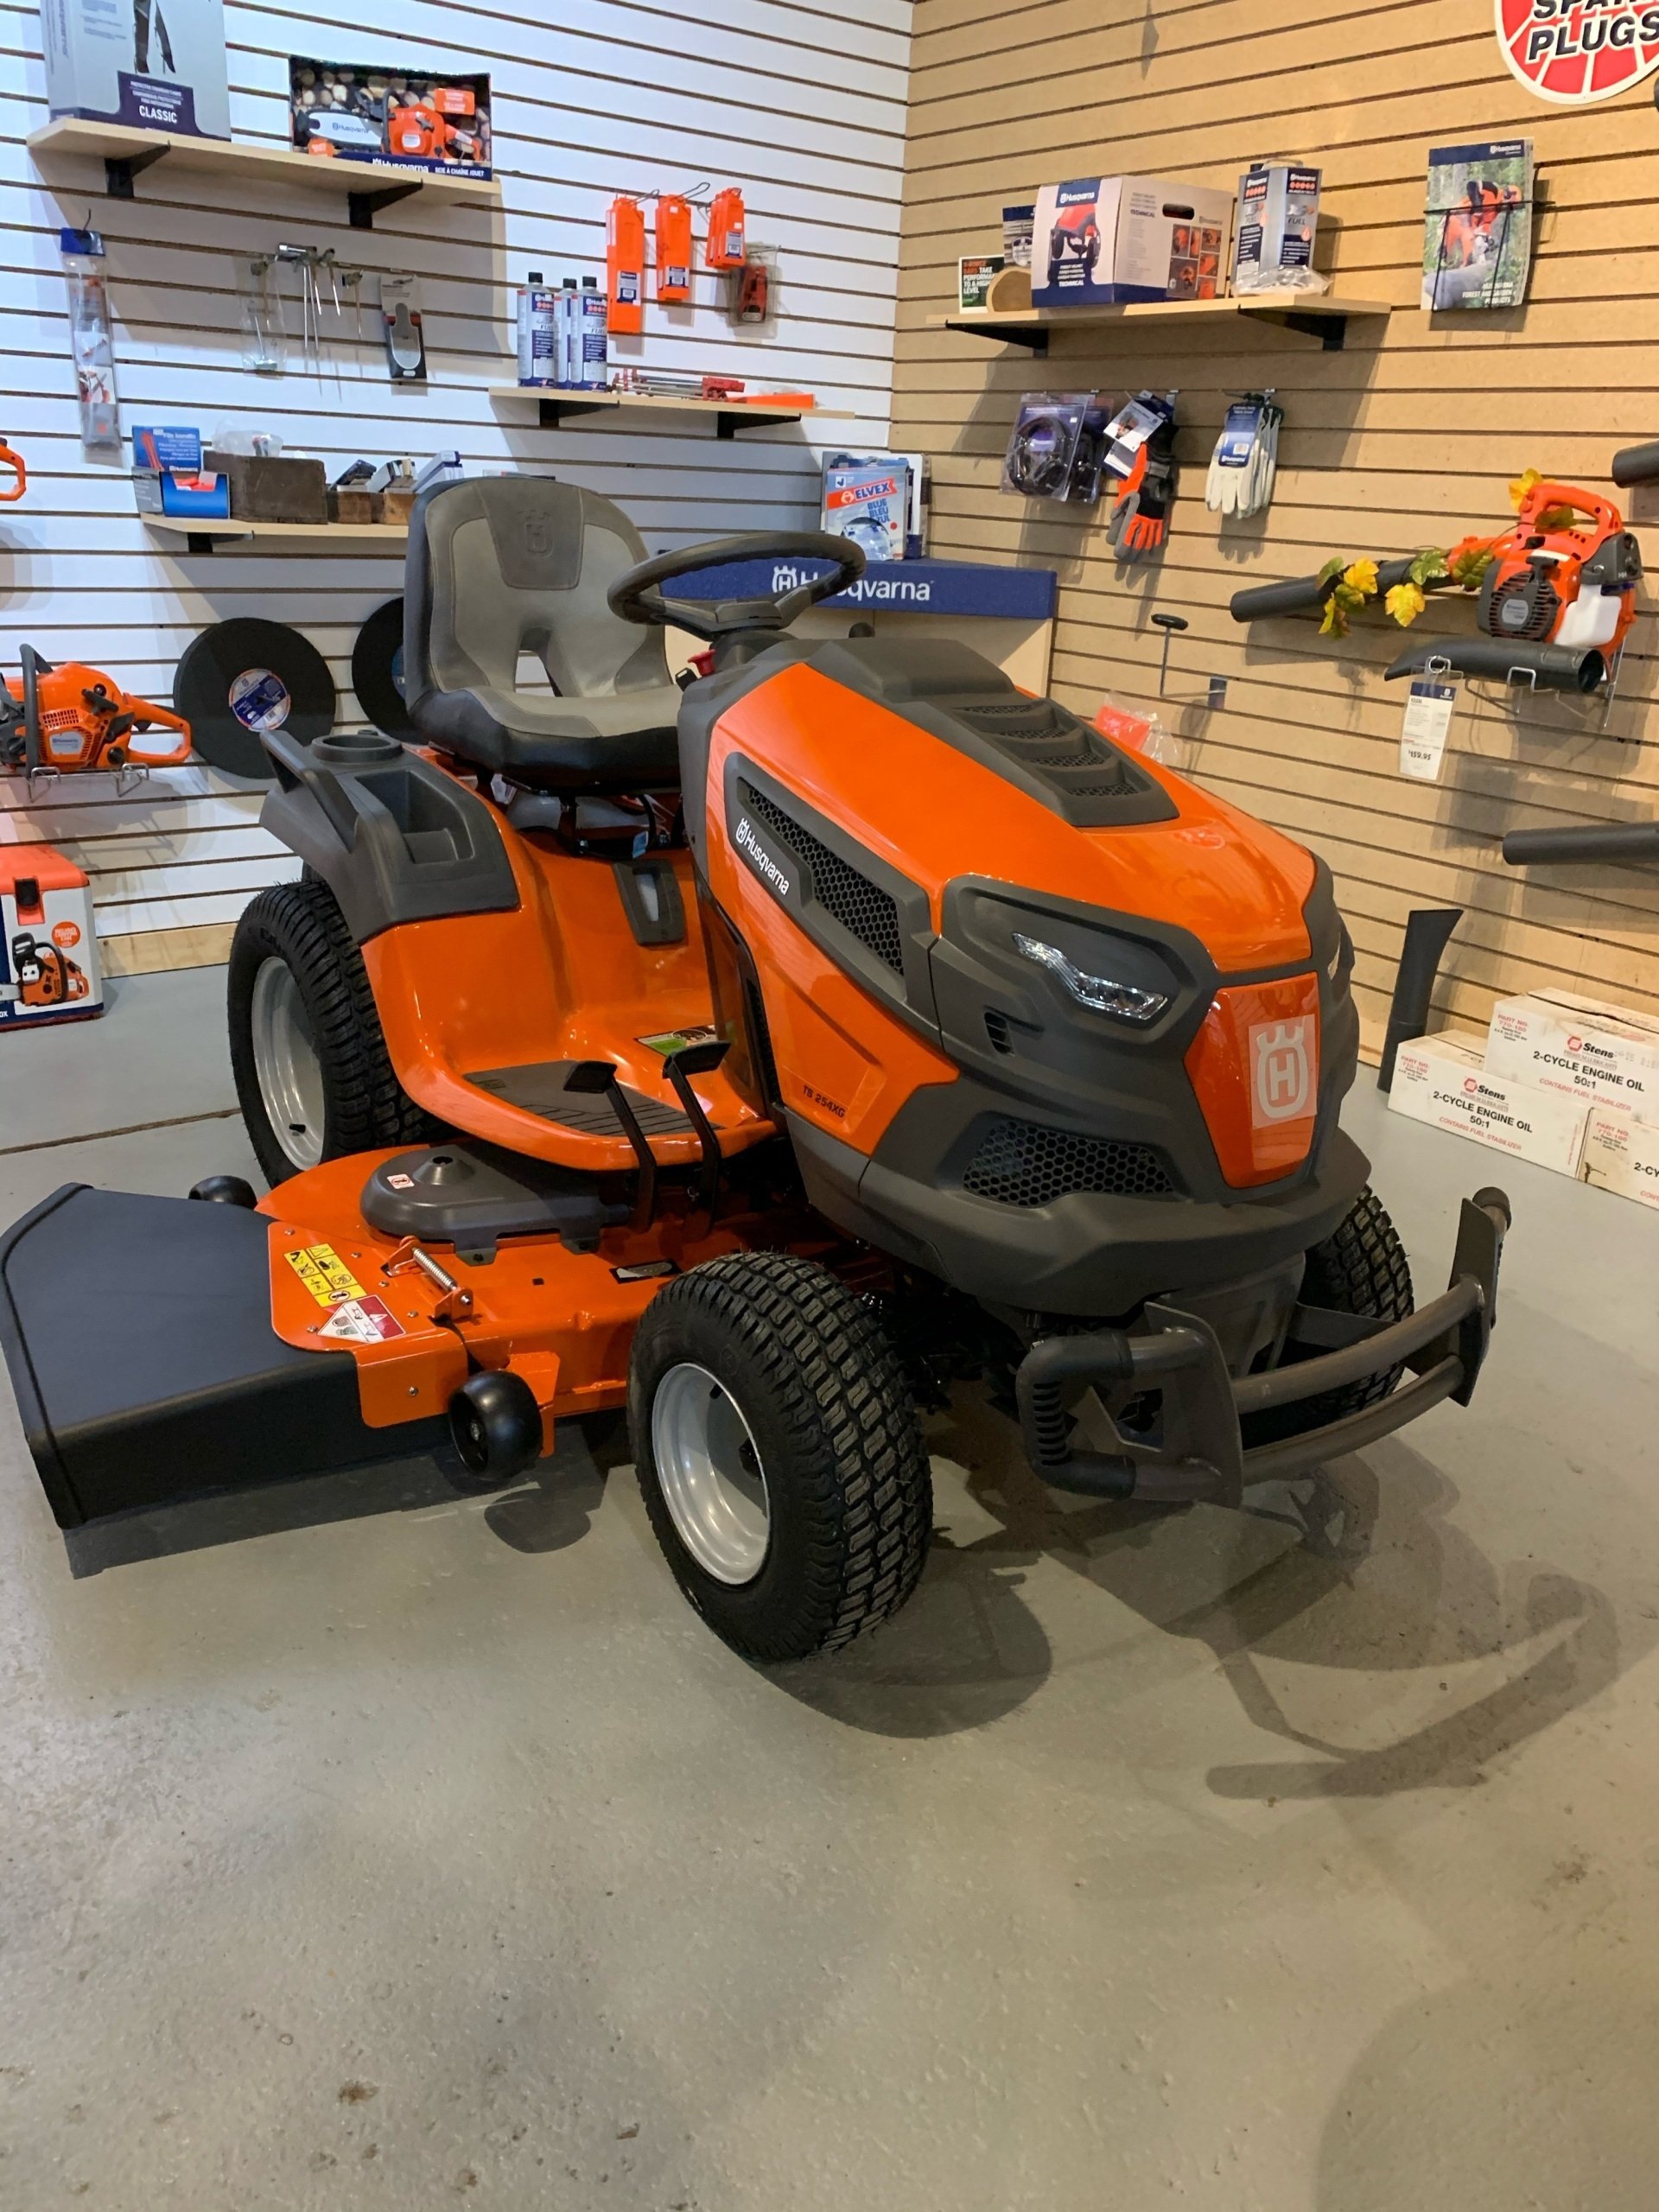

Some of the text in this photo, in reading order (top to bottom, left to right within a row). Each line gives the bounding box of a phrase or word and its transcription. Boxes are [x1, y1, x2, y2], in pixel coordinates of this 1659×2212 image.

[1529, 10, 1659, 60] PLUGS
[138, 105, 178, 124] CLASSIC
[1287, 217, 1306, 226] FUEL
[855, 482, 891, 499] ELVEX
[867, 499, 887, 510] BLUE
[868, 507, 889, 518] BLEU
[801, 571, 931, 601] Hqvarna
[744, 830, 790, 895] Husqvarna
[1583, 1042, 1614, 1058] Stens
[1533, 1051, 1645, 1092] 2-CYCLE ENGINE OIL
[1573, 1075, 1597, 1089] 50:1
[803, 1084, 846, 1118] TS 254XG
[1478, 1084, 1506, 1101] Stens
[1539, 1077, 1632, 1111] CONTAINS FUEL STABILIZER
[1433, 1090, 1533, 1133] 2-CYCLE ENGINE OIL
[1470, 1115, 1490, 1128] 50:1
[1439, 1116, 1522, 1151] CONTAINS FUEL STABILIZER
